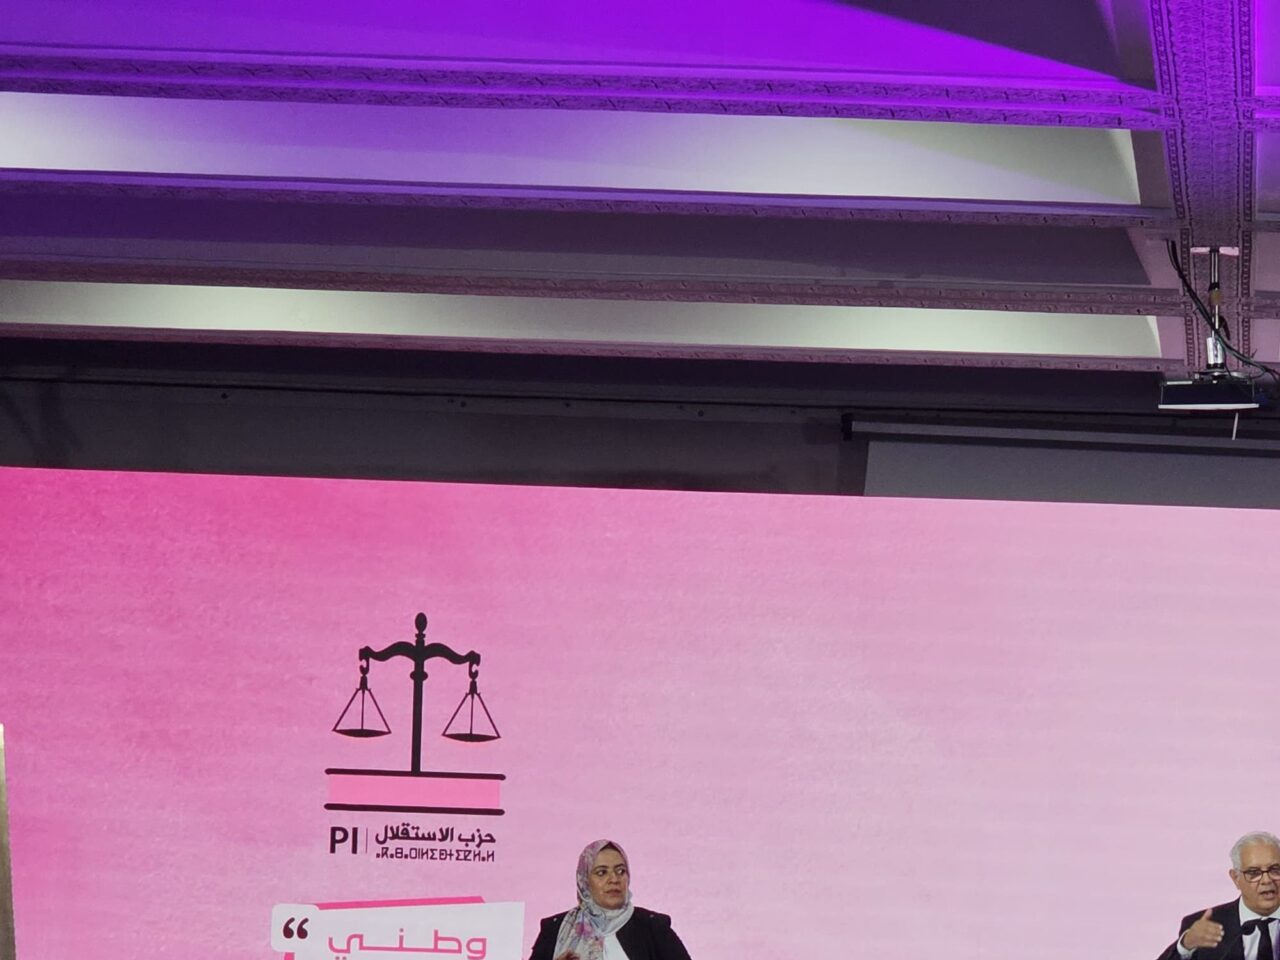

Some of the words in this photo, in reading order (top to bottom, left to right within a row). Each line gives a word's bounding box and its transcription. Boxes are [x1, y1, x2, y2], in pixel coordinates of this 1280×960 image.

[329, 826, 358, 855] PI
[375, 822, 455, 845] الاستقلال
[457, 828, 496, 848] حزب
